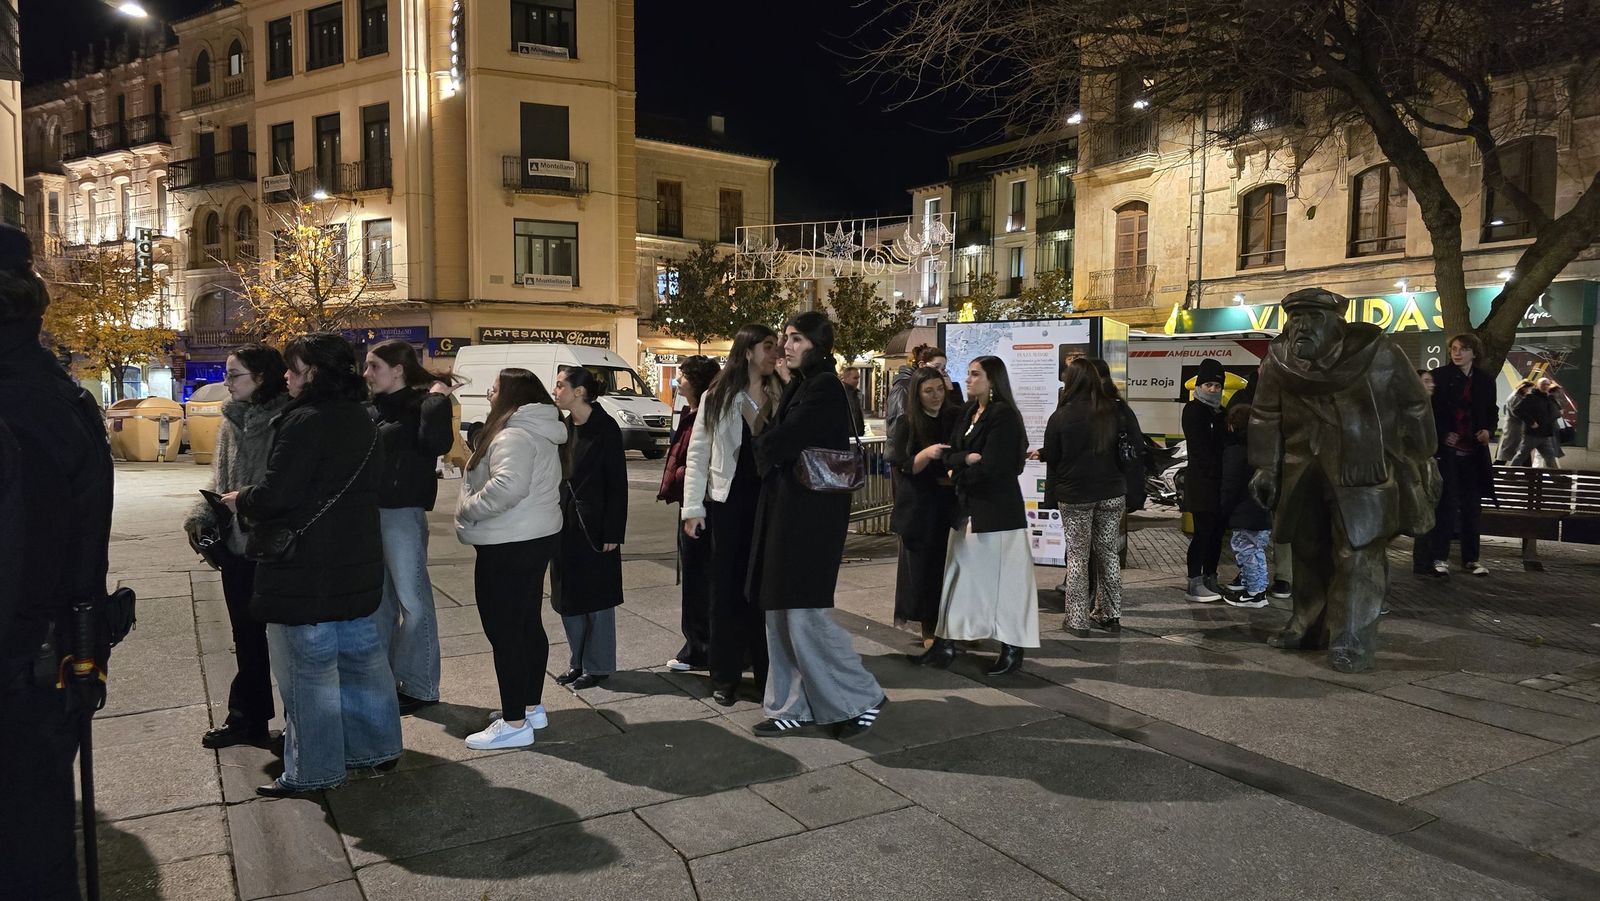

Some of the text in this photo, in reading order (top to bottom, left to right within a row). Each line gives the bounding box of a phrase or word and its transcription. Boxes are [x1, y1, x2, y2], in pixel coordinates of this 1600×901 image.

[540, 162, 575, 171] Montellano
[139, 229, 152, 281] HOTE
[483, 329, 607, 345] ARTESANIA Charra
[440, 338, 454, 351] G
[1167, 349, 1232, 358] AMBULANCIA
[1150, 377, 1175, 389] Roja
